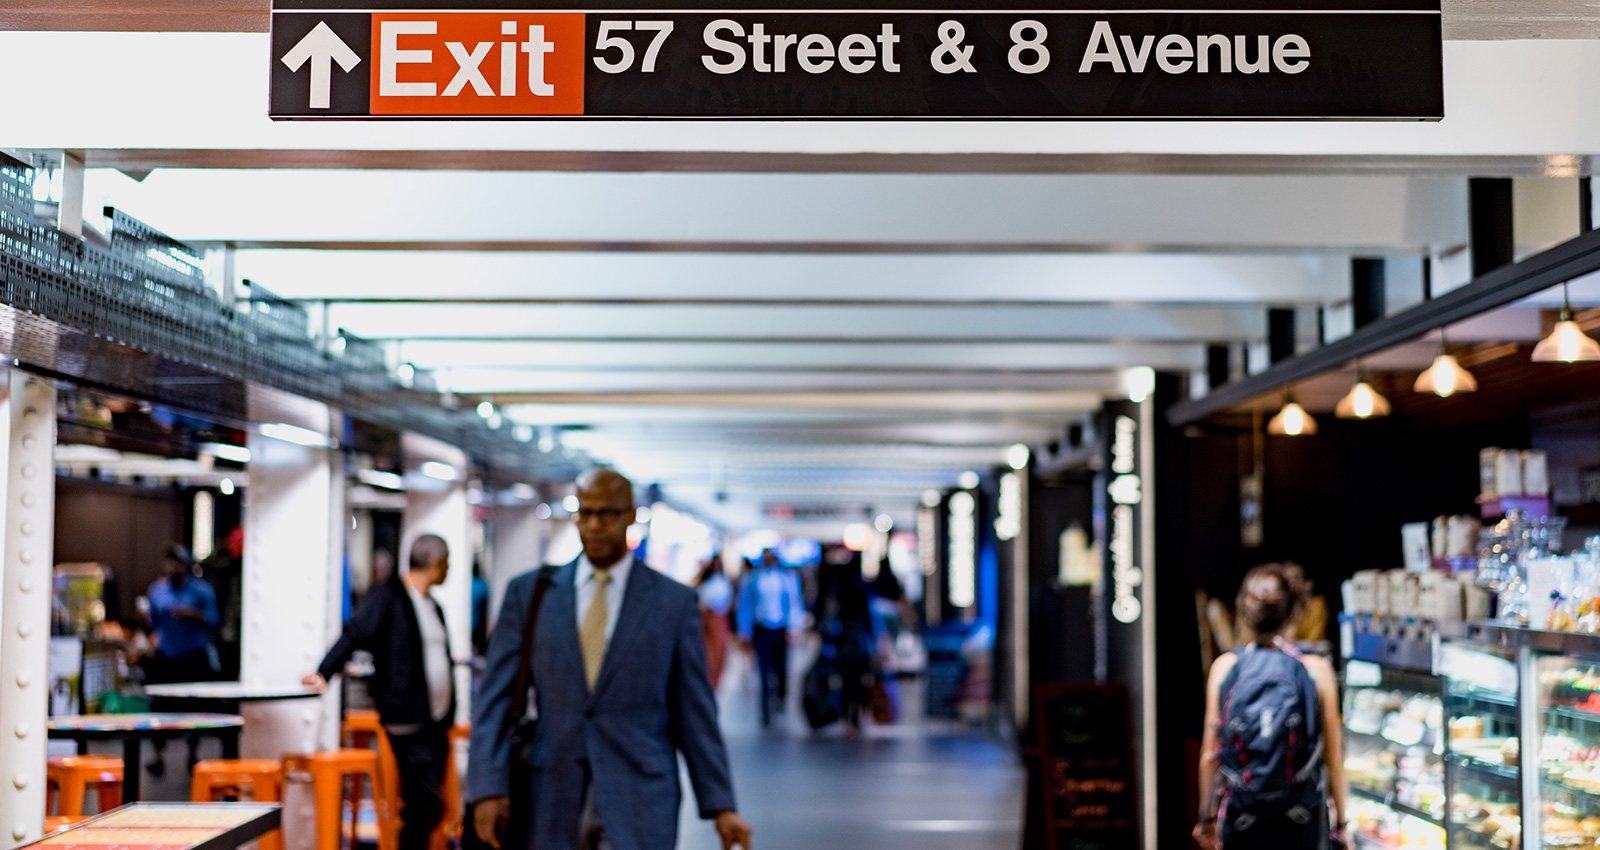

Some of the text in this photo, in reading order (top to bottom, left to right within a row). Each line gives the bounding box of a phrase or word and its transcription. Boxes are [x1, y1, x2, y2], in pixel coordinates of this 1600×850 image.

[379, 18, 1311, 97] Exit 57 Street & 8 Avenue
